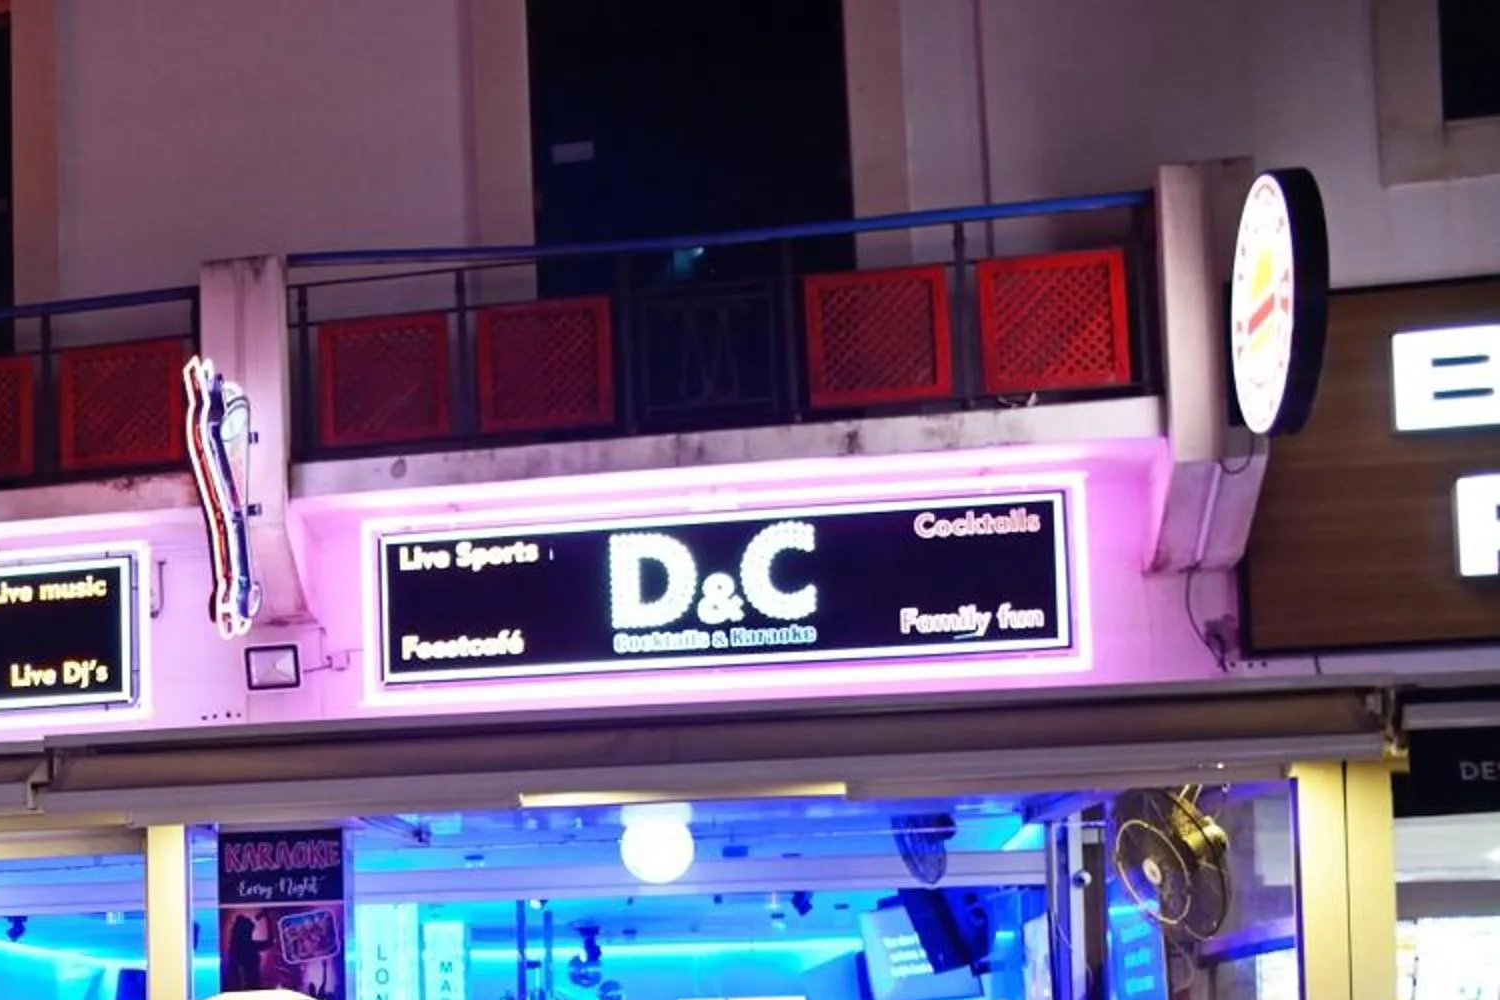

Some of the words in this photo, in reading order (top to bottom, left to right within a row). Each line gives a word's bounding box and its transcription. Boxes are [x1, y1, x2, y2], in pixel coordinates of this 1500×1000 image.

[913, 508, 1041, 539] Cocktails
[400, 546, 450, 571] Live
[455, 541, 539, 572] Sports
[39, 575, 107, 600] music
[609, 520, 817, 629] D&C
[900, 604, 992, 637] Family
[996, 602, 1045, 629] fun
[613, 630, 710, 653] Cocktails
[712, 630, 728, 648] &
[730, 624, 817, 647] Karaoke
[10, 663, 57, 688] Live
[63, 659, 109, 689] Dj's
[1460, 761, 1500, 780] DE
[224, 839, 341, 873] KARAOKE
[279, 875, 324, 898] Night
